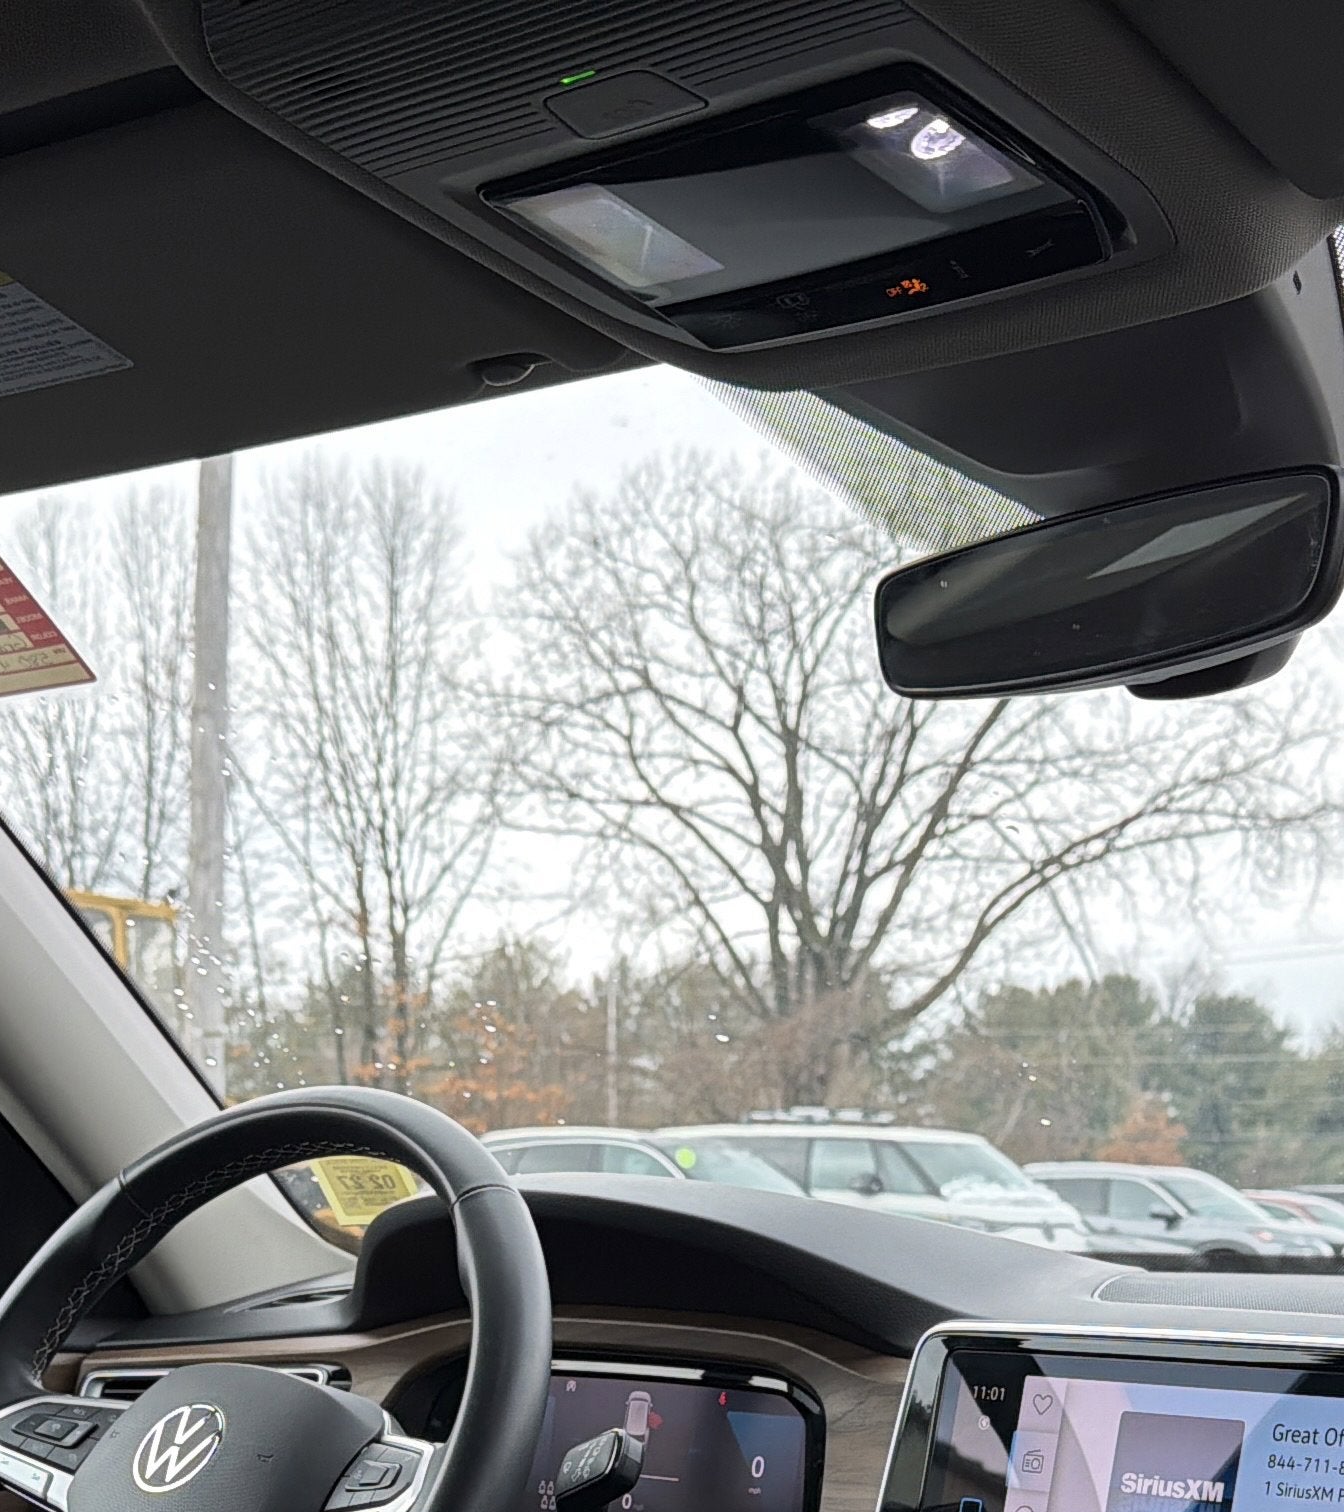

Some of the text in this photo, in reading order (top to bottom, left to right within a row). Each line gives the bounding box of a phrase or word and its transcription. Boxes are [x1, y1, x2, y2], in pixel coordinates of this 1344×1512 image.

[973, 1385, 1006, 1401] 11:01
[1272, 1423, 1320, 1446] Great
[751, 1455, 765, 1478] 0
[1120, 1472, 1225, 1503] SiriusXM
[1265, 1481, 1271, 1496] 1
[1275, 1482, 1334, 1502] SiriusXM
[622, 1493, 632, 1509] 0
